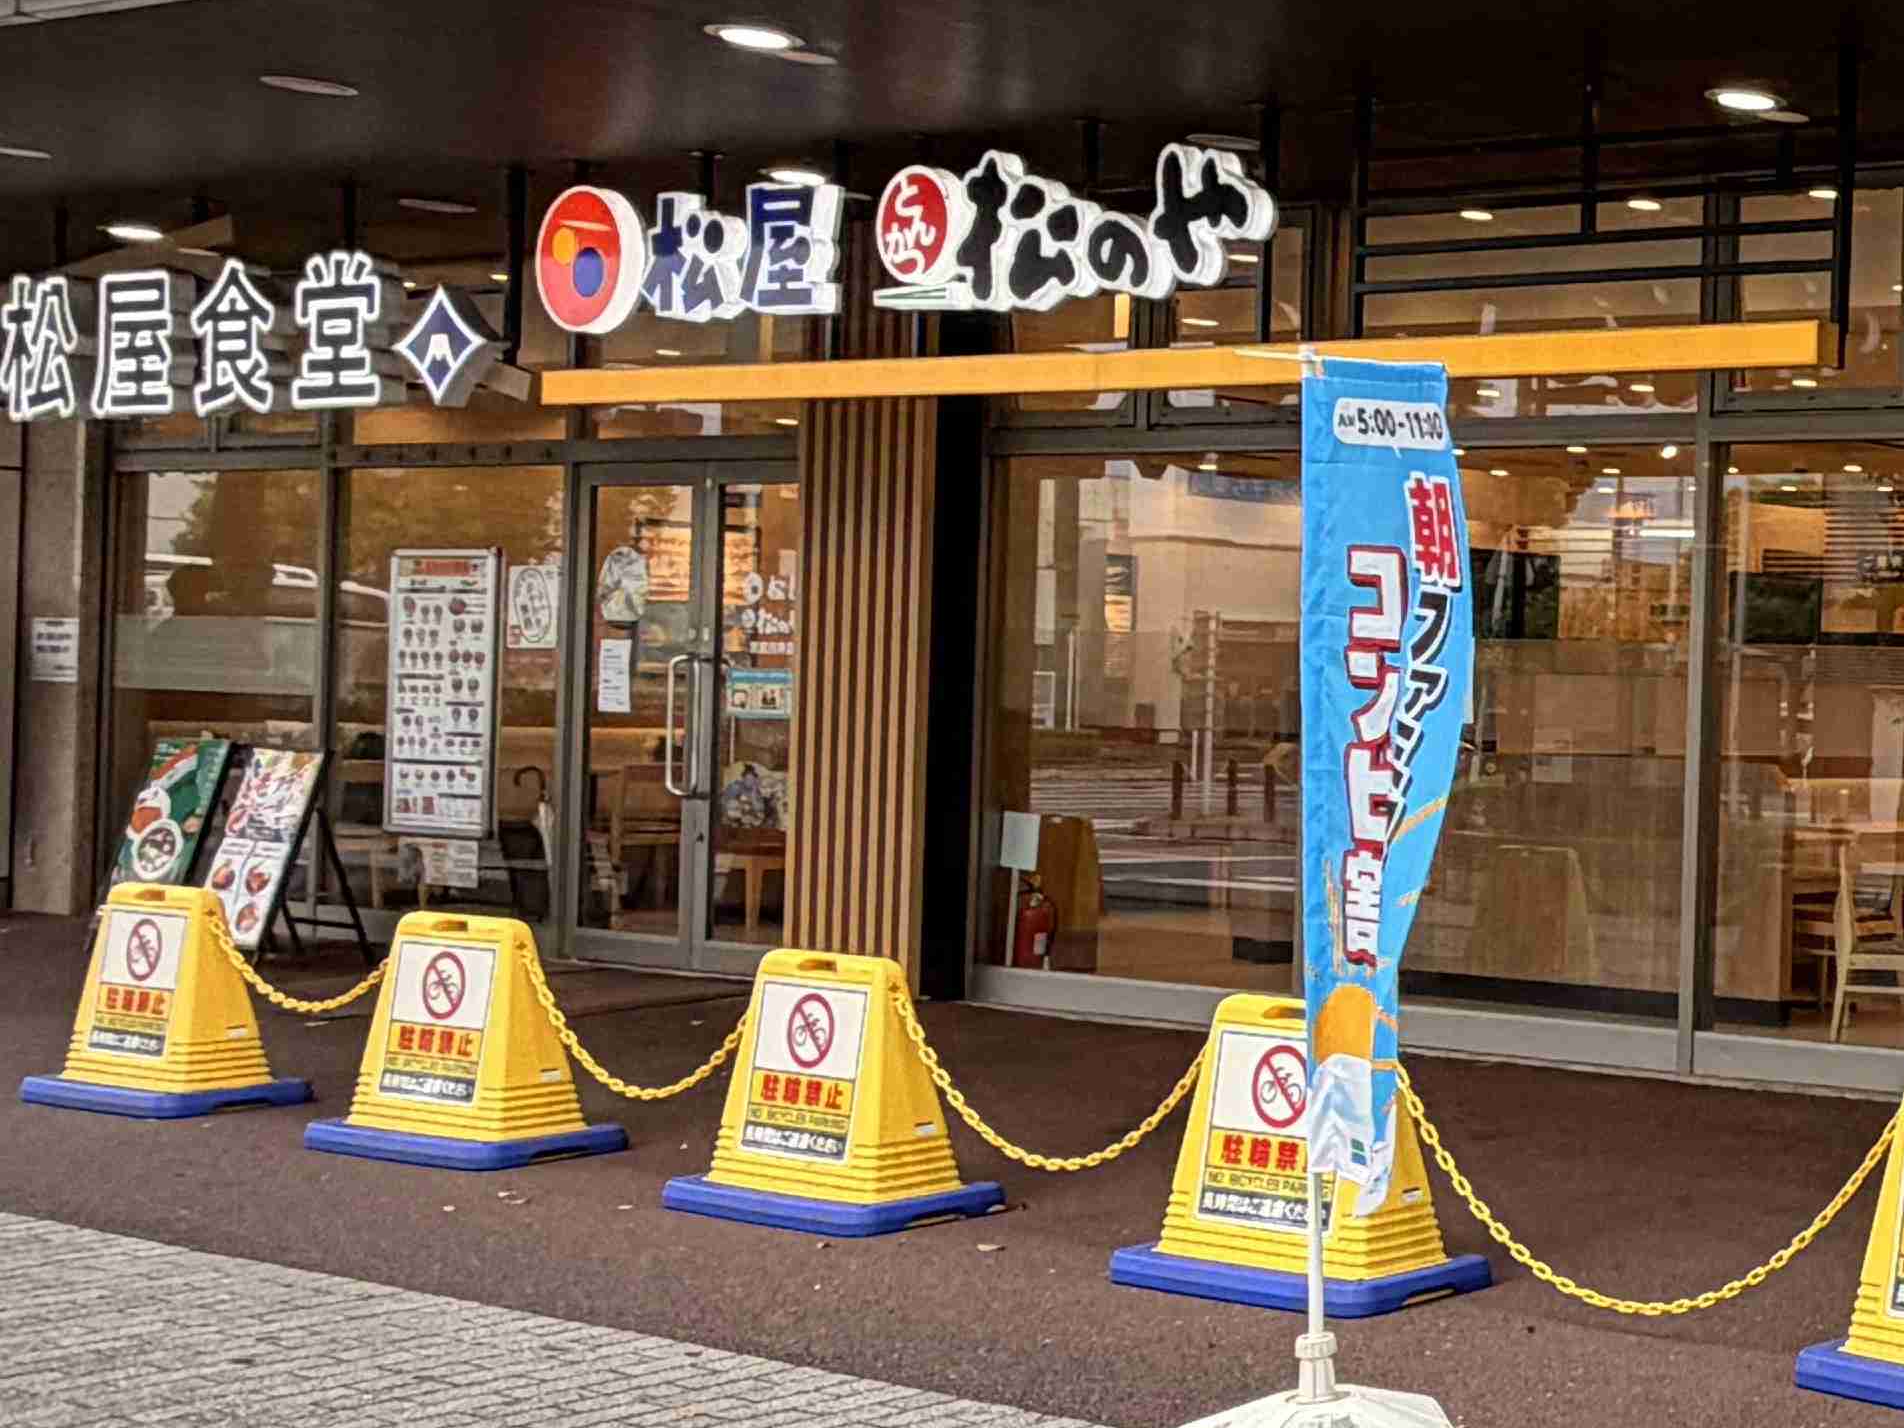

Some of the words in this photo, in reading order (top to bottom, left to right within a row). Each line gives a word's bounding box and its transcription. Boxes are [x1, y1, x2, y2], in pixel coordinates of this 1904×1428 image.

[641, 184, 832, 318] 松屋
[955, 142, 1256, 310] 松のや
[1, 251, 382, 422] 松屋食堂
[1221, 1134, 1307, 1173] 駐輪禁
